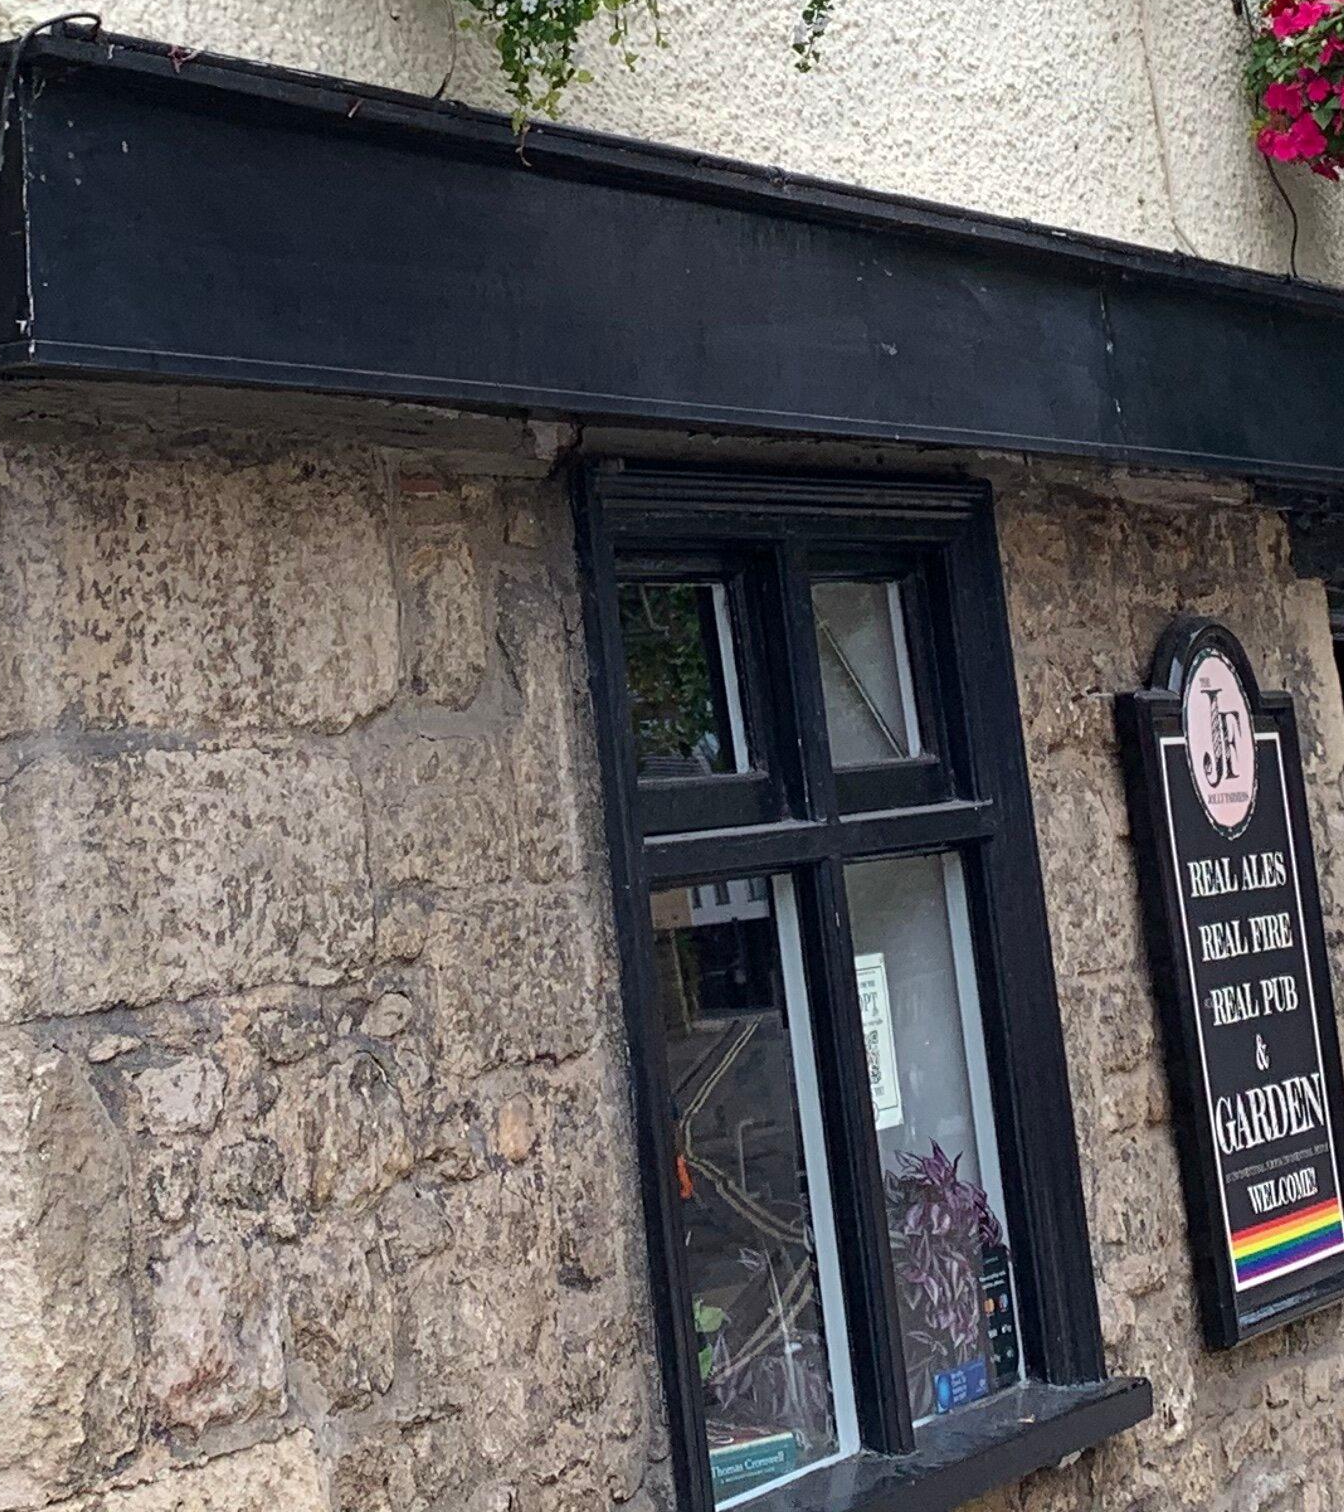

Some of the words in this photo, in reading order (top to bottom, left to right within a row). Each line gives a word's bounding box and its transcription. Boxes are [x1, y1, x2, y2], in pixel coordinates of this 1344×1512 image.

[1187, 857, 1238, 898] REAL
[1241, 851, 1287, 891] ALES
[1198, 920, 1249, 962] REAL
[1248, 912, 1294, 953] FIRE
[1210, 982, 1260, 1026] REAL
[1260, 975, 1298, 1015] PUB
[1256, 1033, 1270, 1072] &
[1215, 1073, 1324, 1155] GARDEN
[1247, 1167, 1318, 1214] WELCOME!
